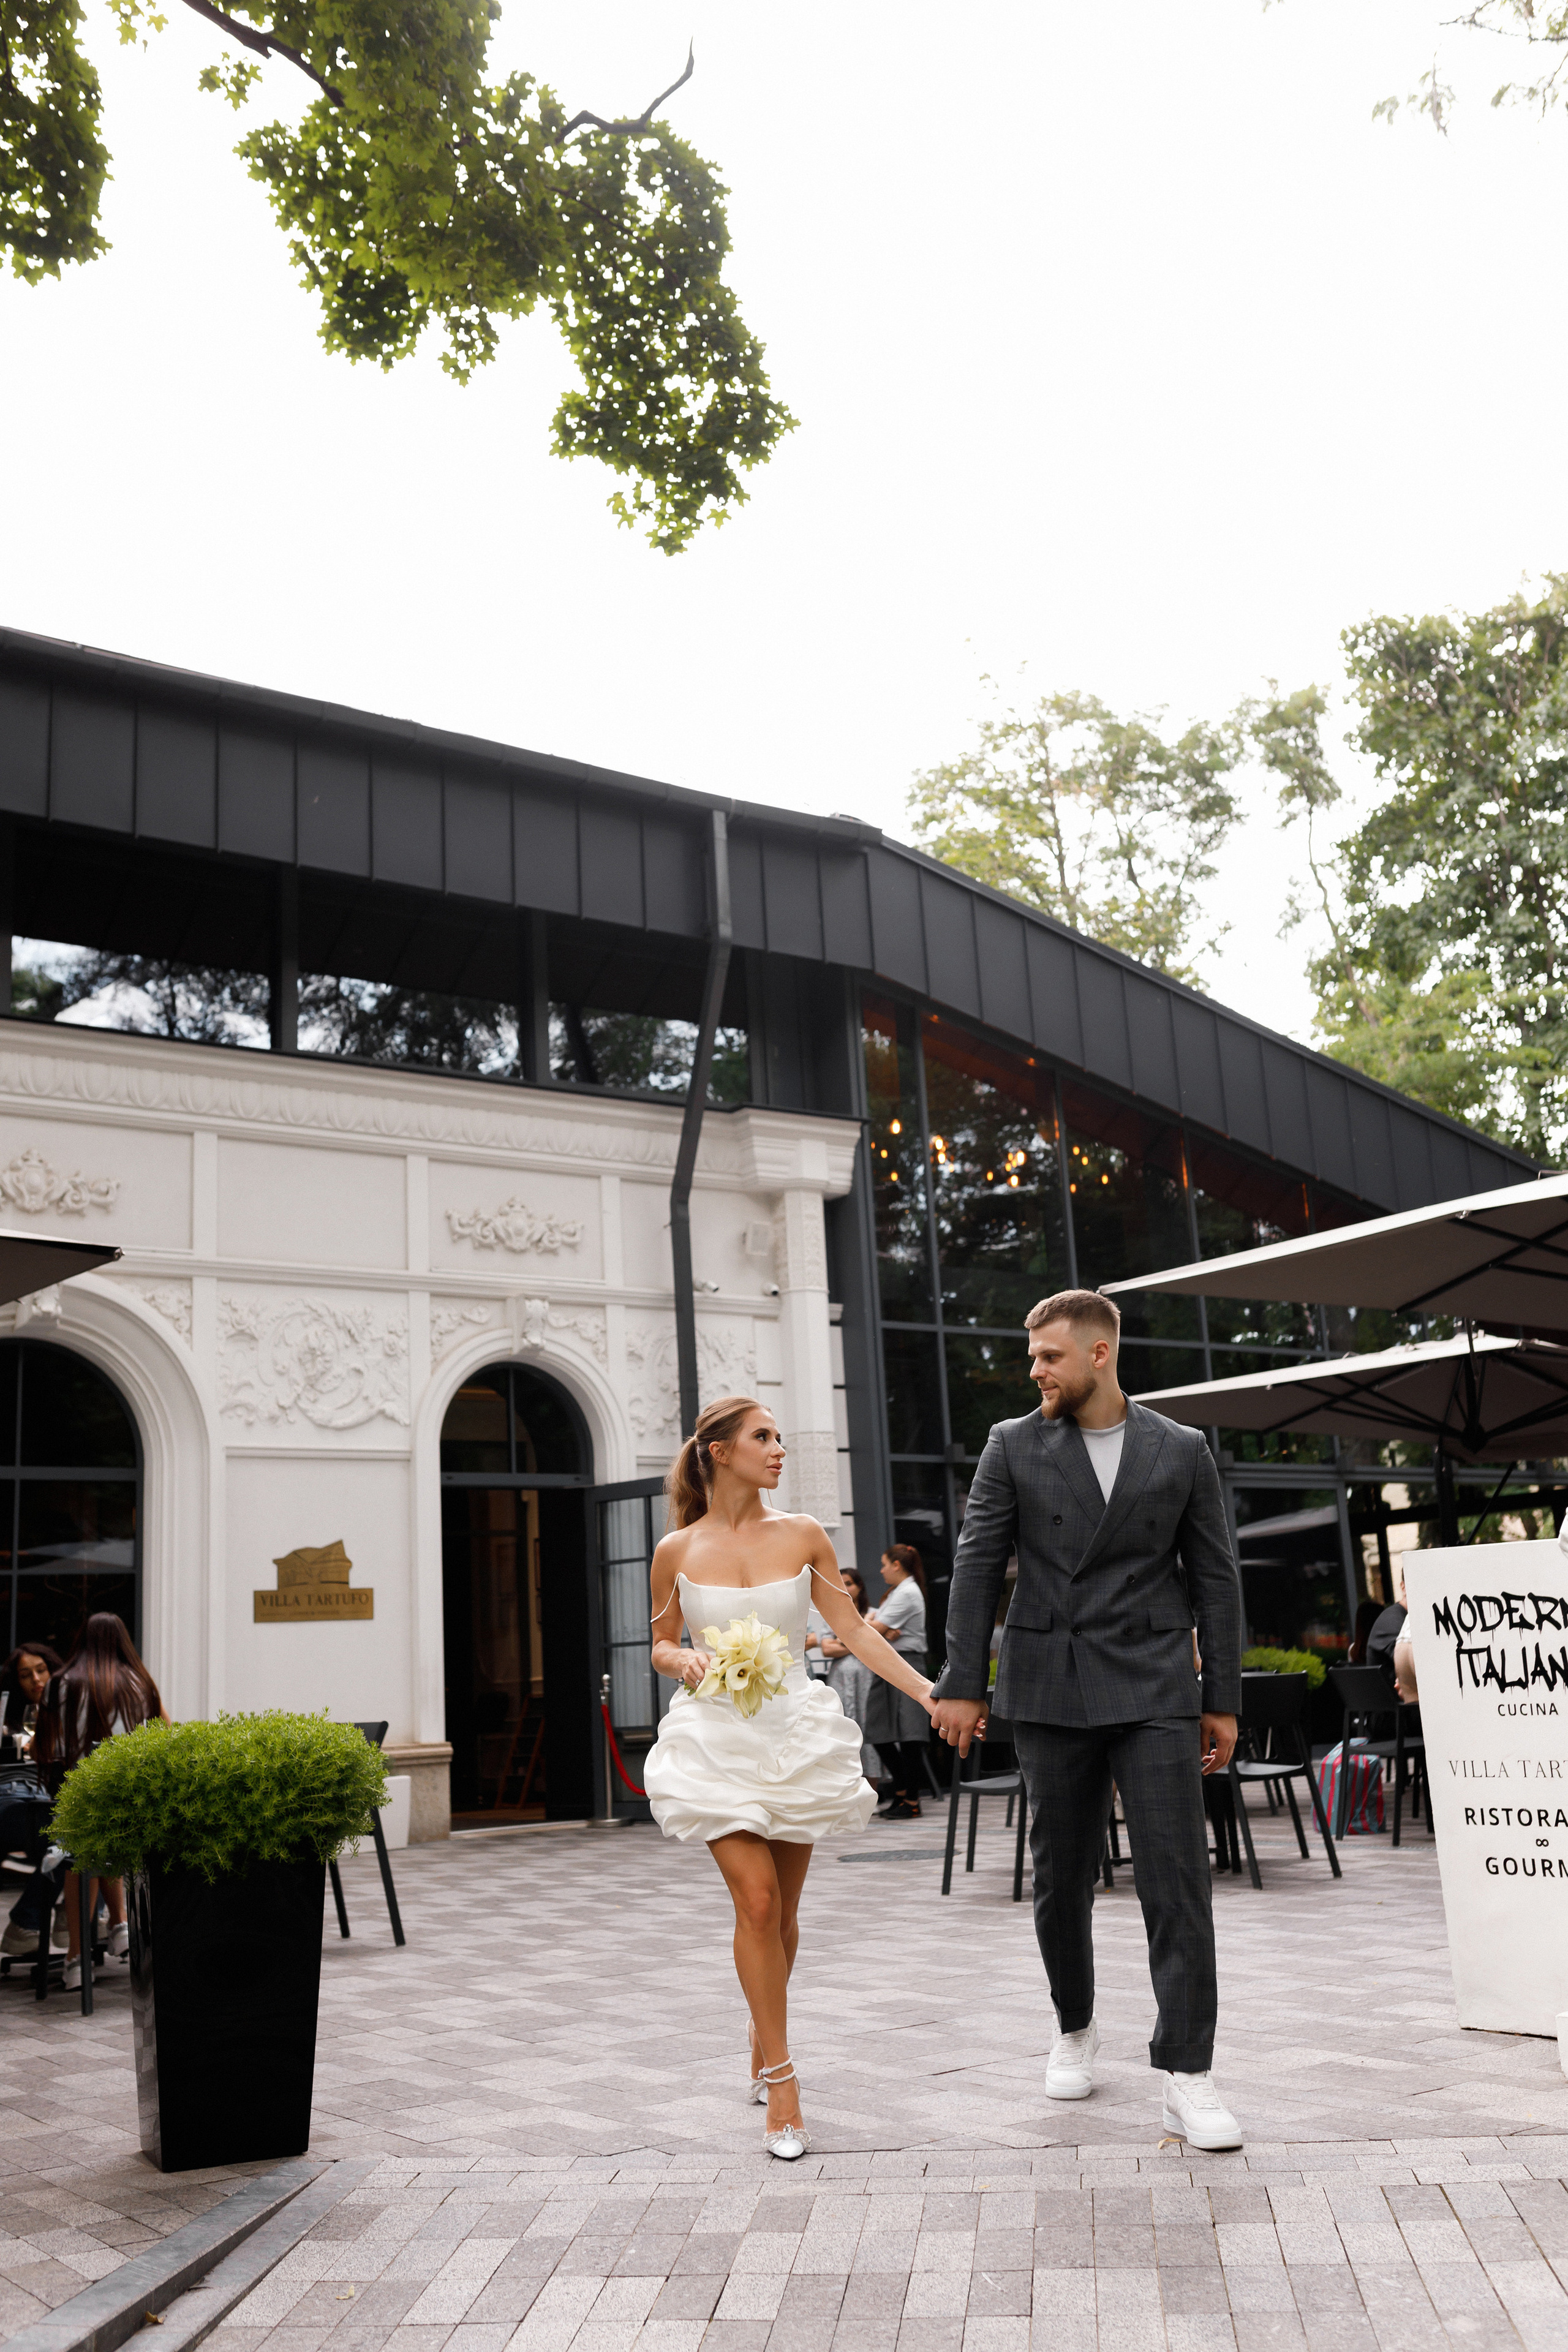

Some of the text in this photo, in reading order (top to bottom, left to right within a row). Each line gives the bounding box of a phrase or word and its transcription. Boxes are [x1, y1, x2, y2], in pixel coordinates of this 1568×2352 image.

[260, 1593, 369, 1607] VILLA TARTUFO
[1498, 1703, 1559, 1716] CUCINA
[1449, 1760, 1568, 1779] VILLA TAR
[1464, 1807, 1568, 1827] RISTORA
